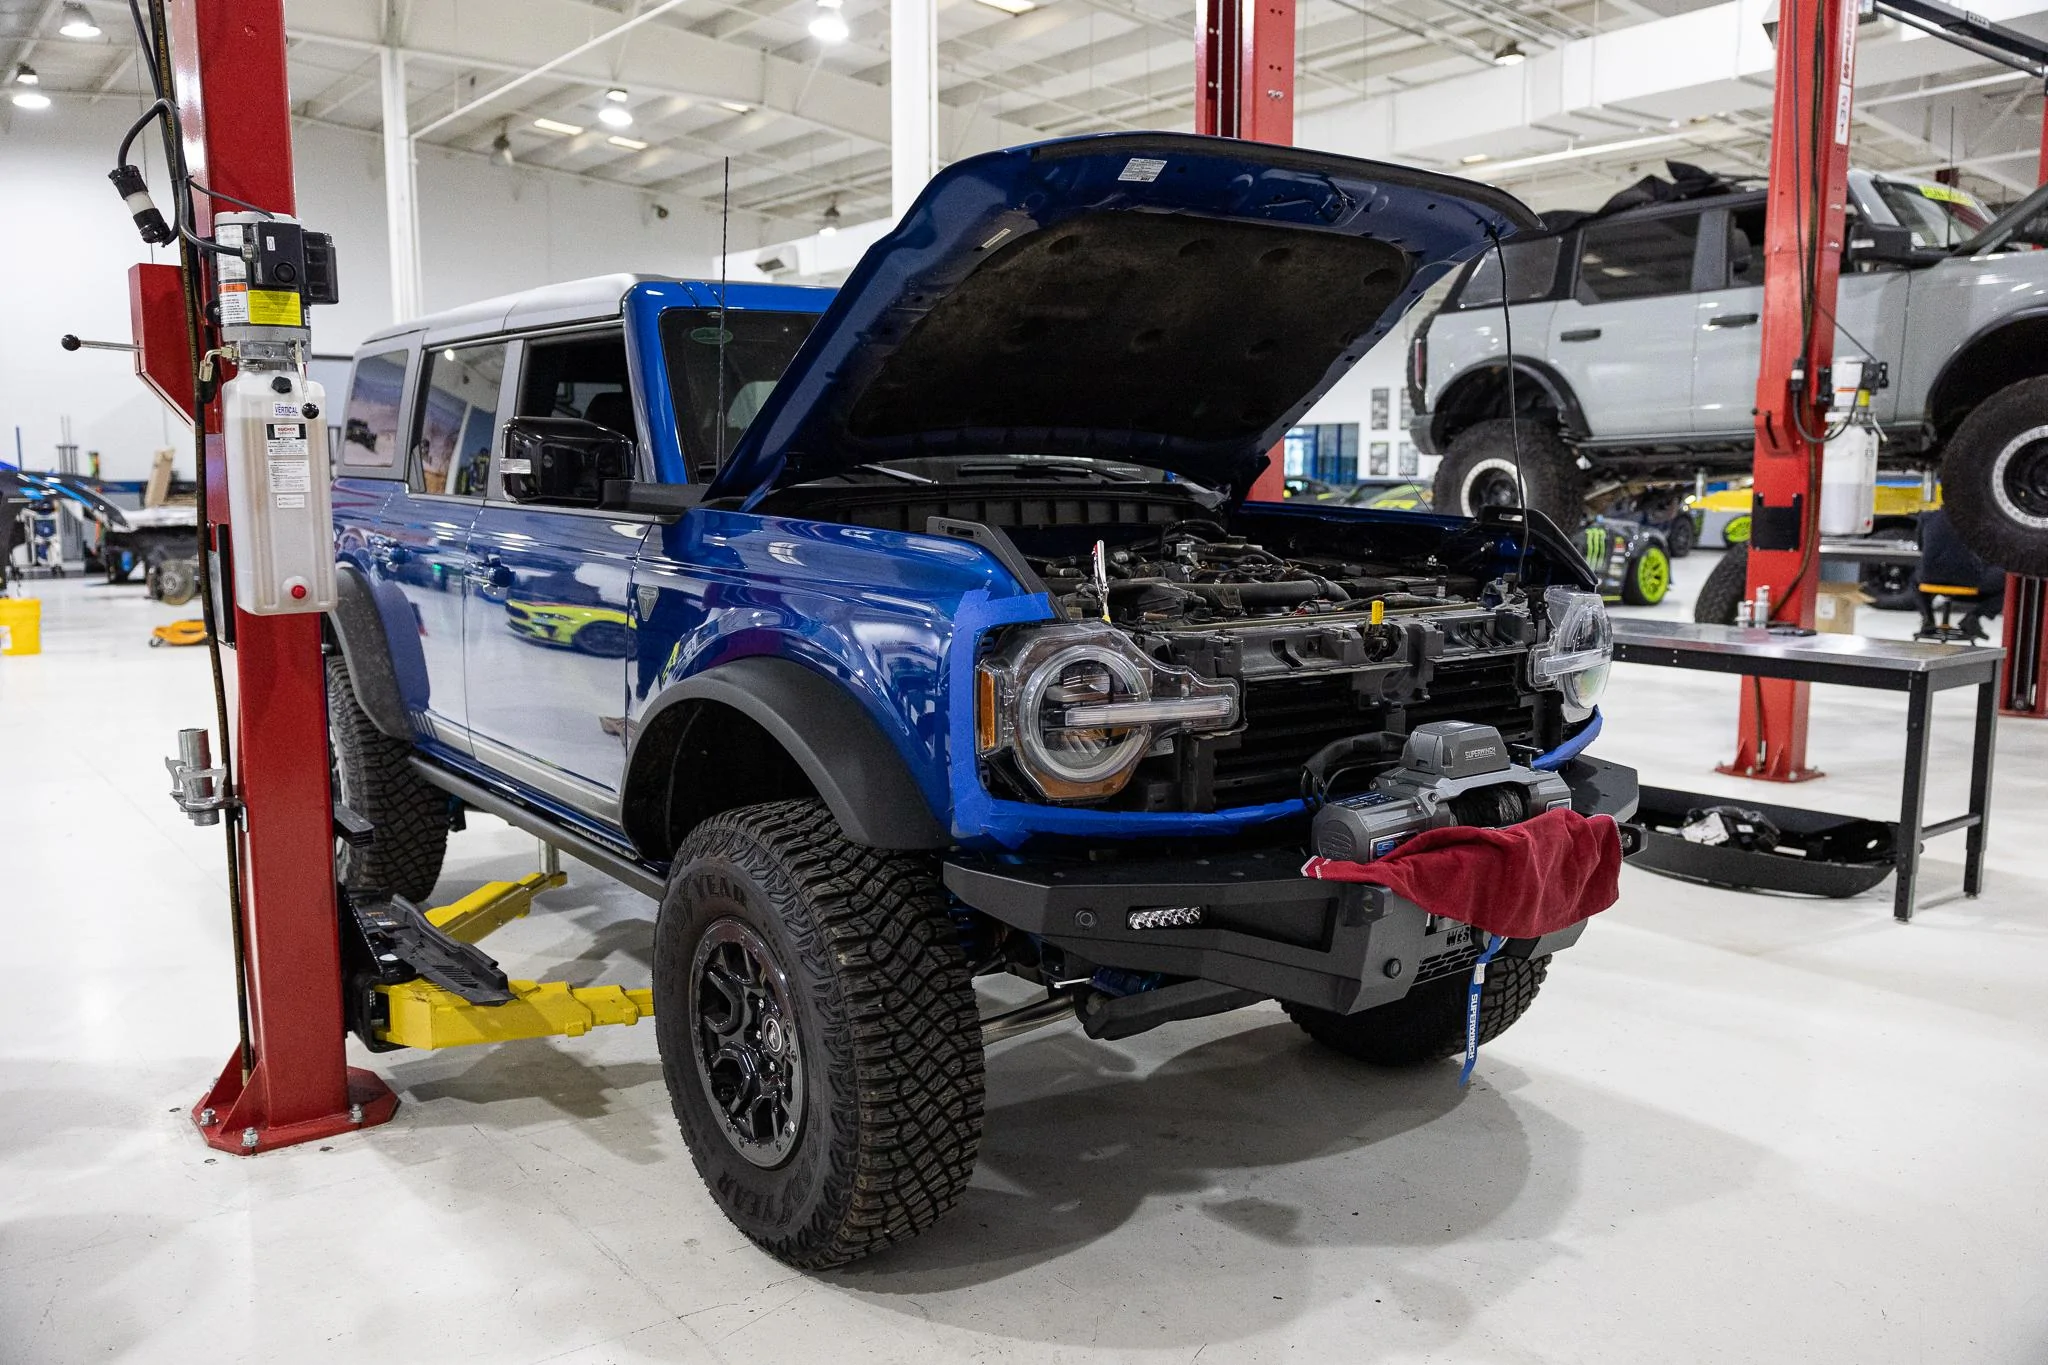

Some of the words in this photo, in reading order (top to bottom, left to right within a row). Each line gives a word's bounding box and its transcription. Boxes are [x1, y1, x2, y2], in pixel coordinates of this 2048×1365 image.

[275, 406, 299, 414] VERTICAL
[1465, 747, 1496, 760] SUPERWINCH
[1467, 993, 1479, 1060] SUPERWINCH
